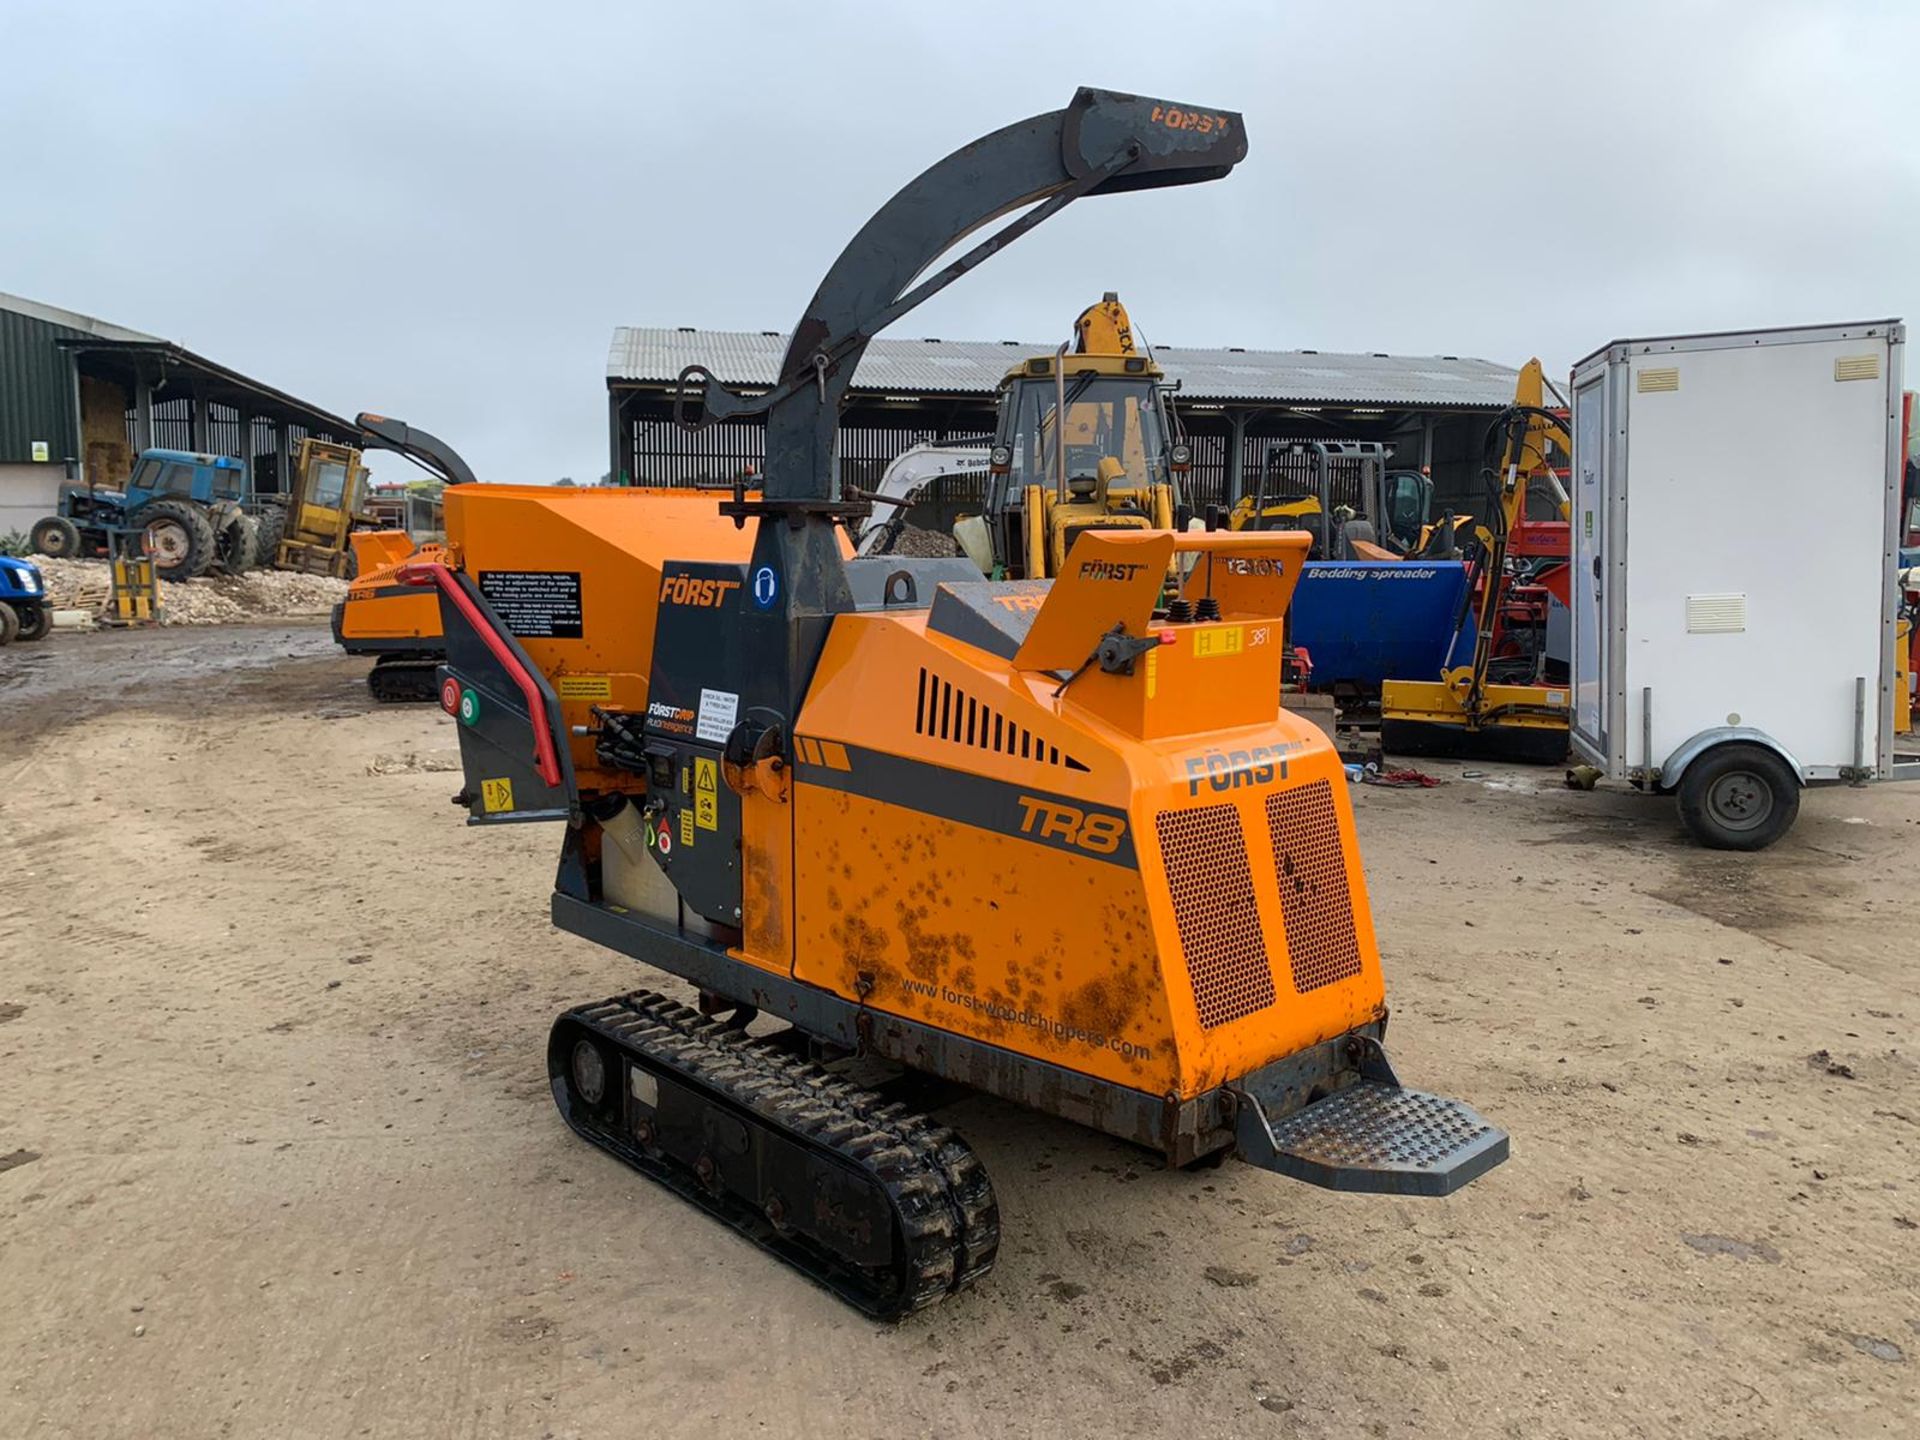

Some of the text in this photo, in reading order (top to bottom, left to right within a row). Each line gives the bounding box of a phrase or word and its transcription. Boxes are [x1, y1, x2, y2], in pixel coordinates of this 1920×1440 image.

[1116, 326, 1134, 354] 3CX
[967, 458, 990, 468] Bobca
[1079, 559, 1141, 581] FÖRST
[1308, 567, 1436, 580] Bedding Spreader
[660, 573, 738, 608] FÖRST
[1185, 742, 1299, 796] FÖRST
[1018, 795, 1126, 855] TR8
[901, 978, 1152, 1061] wwwforst-woodchippers.com
